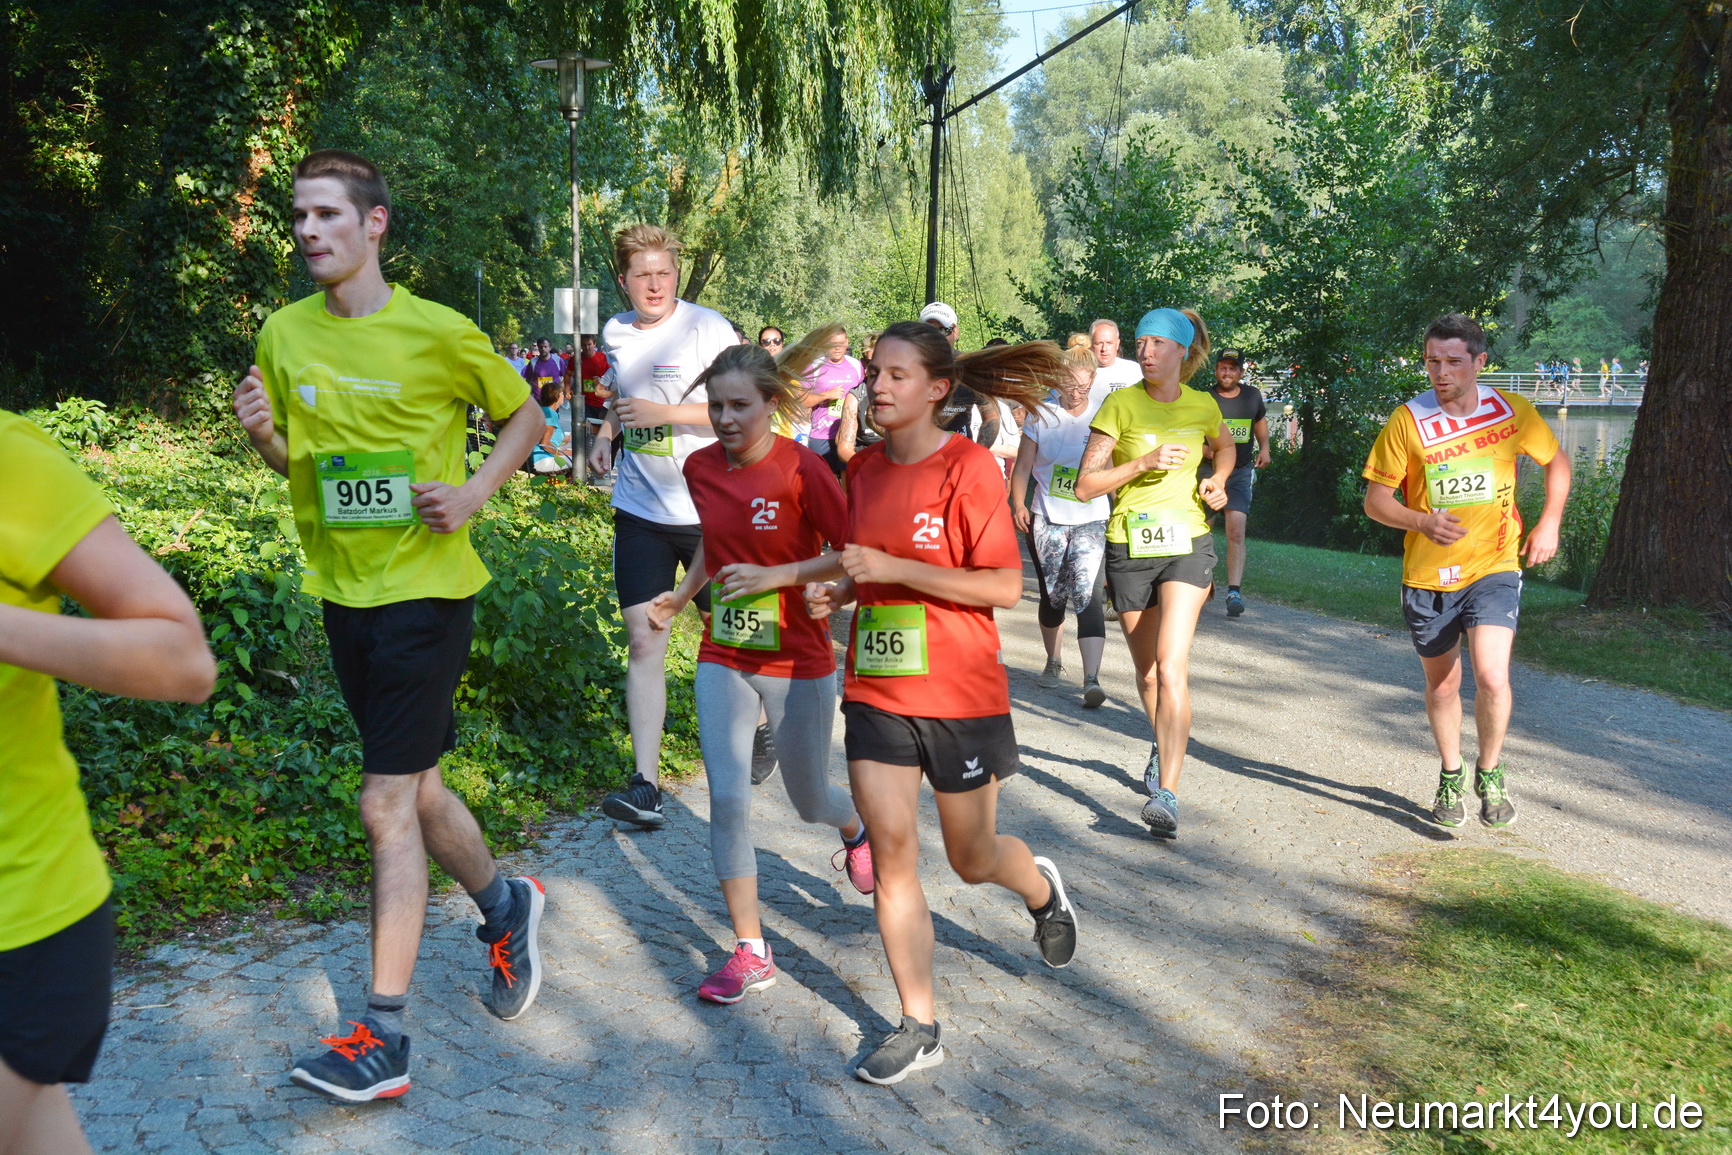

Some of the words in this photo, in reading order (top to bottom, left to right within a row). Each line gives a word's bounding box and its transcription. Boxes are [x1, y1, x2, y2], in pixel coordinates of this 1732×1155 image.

[630, 426, 664, 442] 1415
[1426, 442, 1470, 465] MAX
[1474, 424, 1518, 449] BÖGL
[336, 479, 393, 507] 905
[1436, 474, 1486, 496] 1232
[751, 497, 780, 524] 25
[912, 512, 944, 542] 25
[1141, 526, 1175, 544] 941
[722, 608, 760, 632] 455
[864, 631, 904, 656] 456
